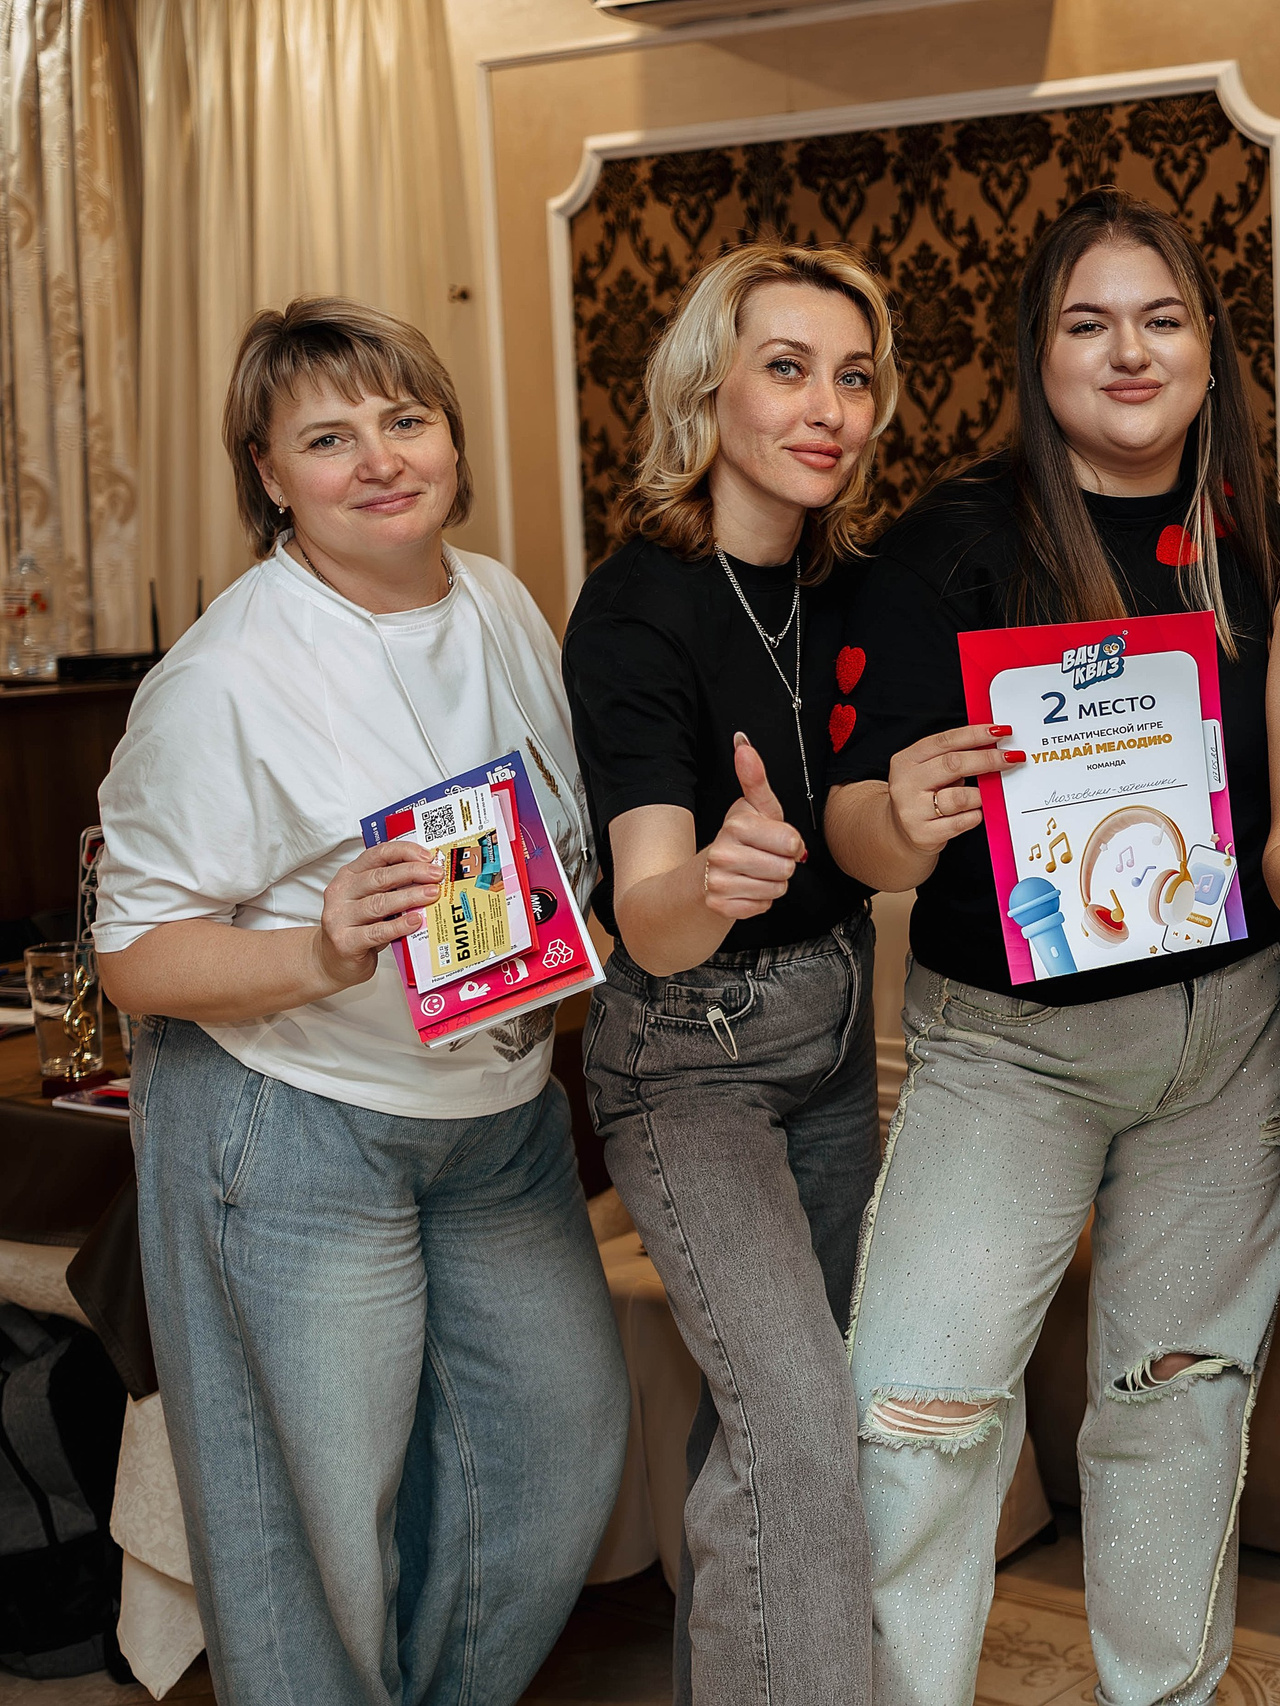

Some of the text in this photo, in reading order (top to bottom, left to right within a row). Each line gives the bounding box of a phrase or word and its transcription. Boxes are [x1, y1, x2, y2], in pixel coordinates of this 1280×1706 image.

[1062, 643, 1100, 672] ВАУ
[1074, 656, 1120, 686] КВИЗ
[1040, 691, 1157, 725] 2 МЕСТО
[1041, 720, 1164, 746] В ТЕМАТИЧЕСКОЙ ИГРЕ
[1030, 733, 1174, 764] УГАДАЙ МЕЛОДИЮ
[1086, 759, 1127, 771] КОМАНДА
[451, 904, 471, 962] БИЛЕТ
